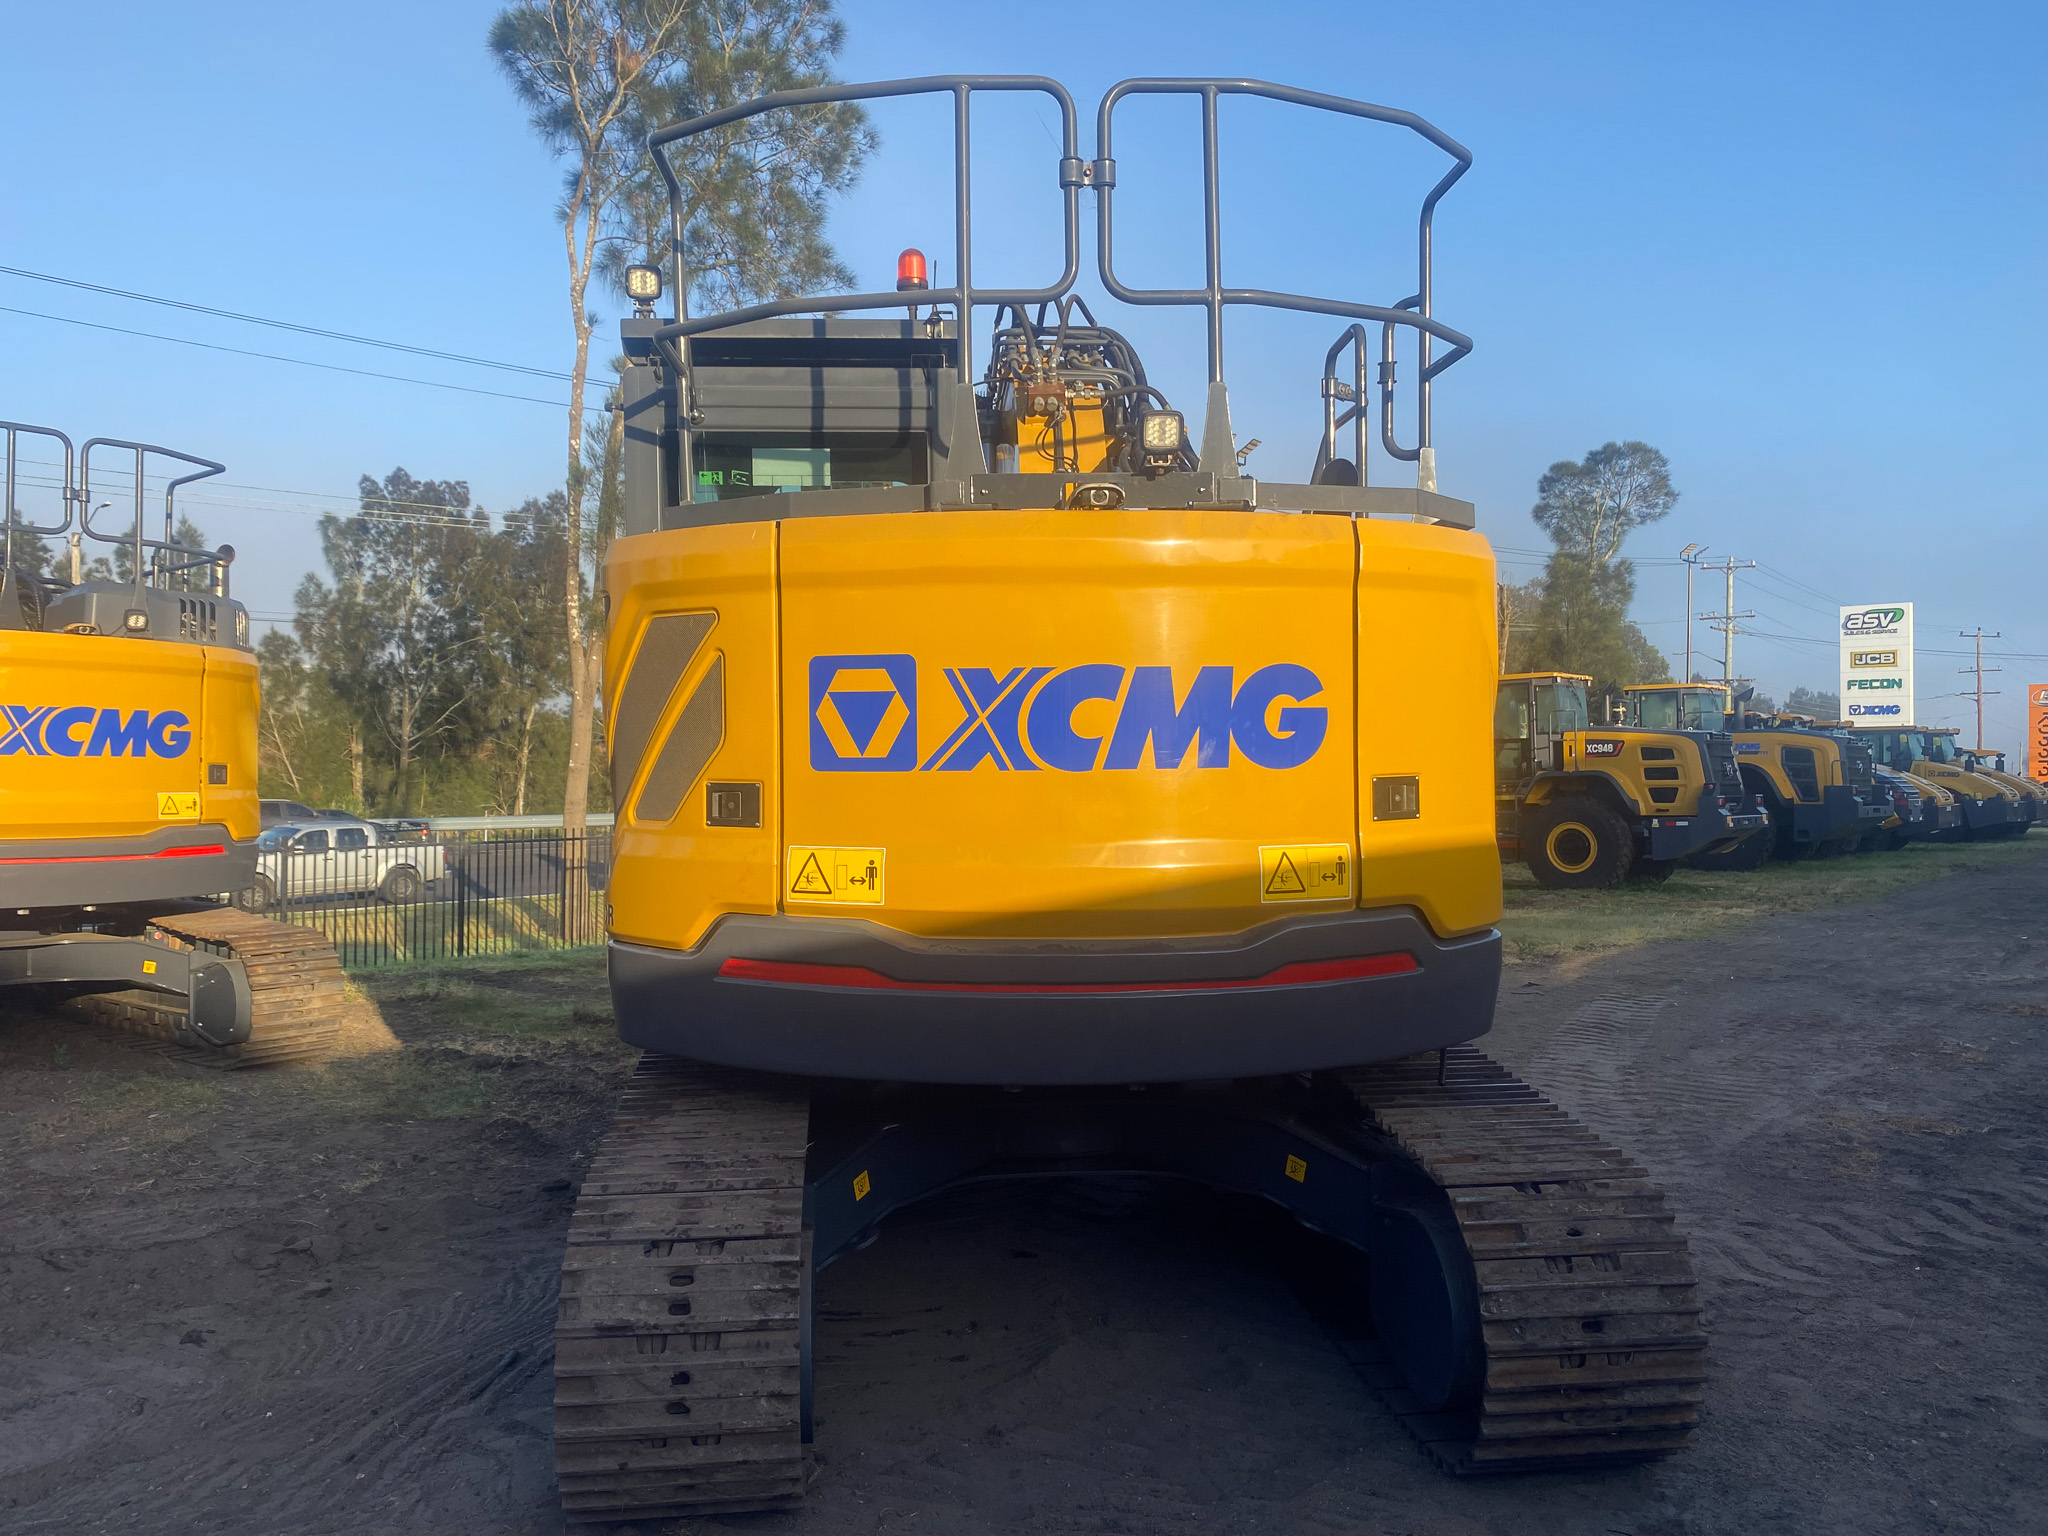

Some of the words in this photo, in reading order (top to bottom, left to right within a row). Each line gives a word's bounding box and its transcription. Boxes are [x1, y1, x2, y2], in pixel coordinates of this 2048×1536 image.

[1855, 653, 1895, 665] JCB
[1847, 678, 1903, 690] FECON
[1861, 704, 1901, 716] XCMG
[918, 662, 1329, 773] XCMG
[0, 694, 192, 760] XCMG
[1586, 743, 1614, 753] XC948
